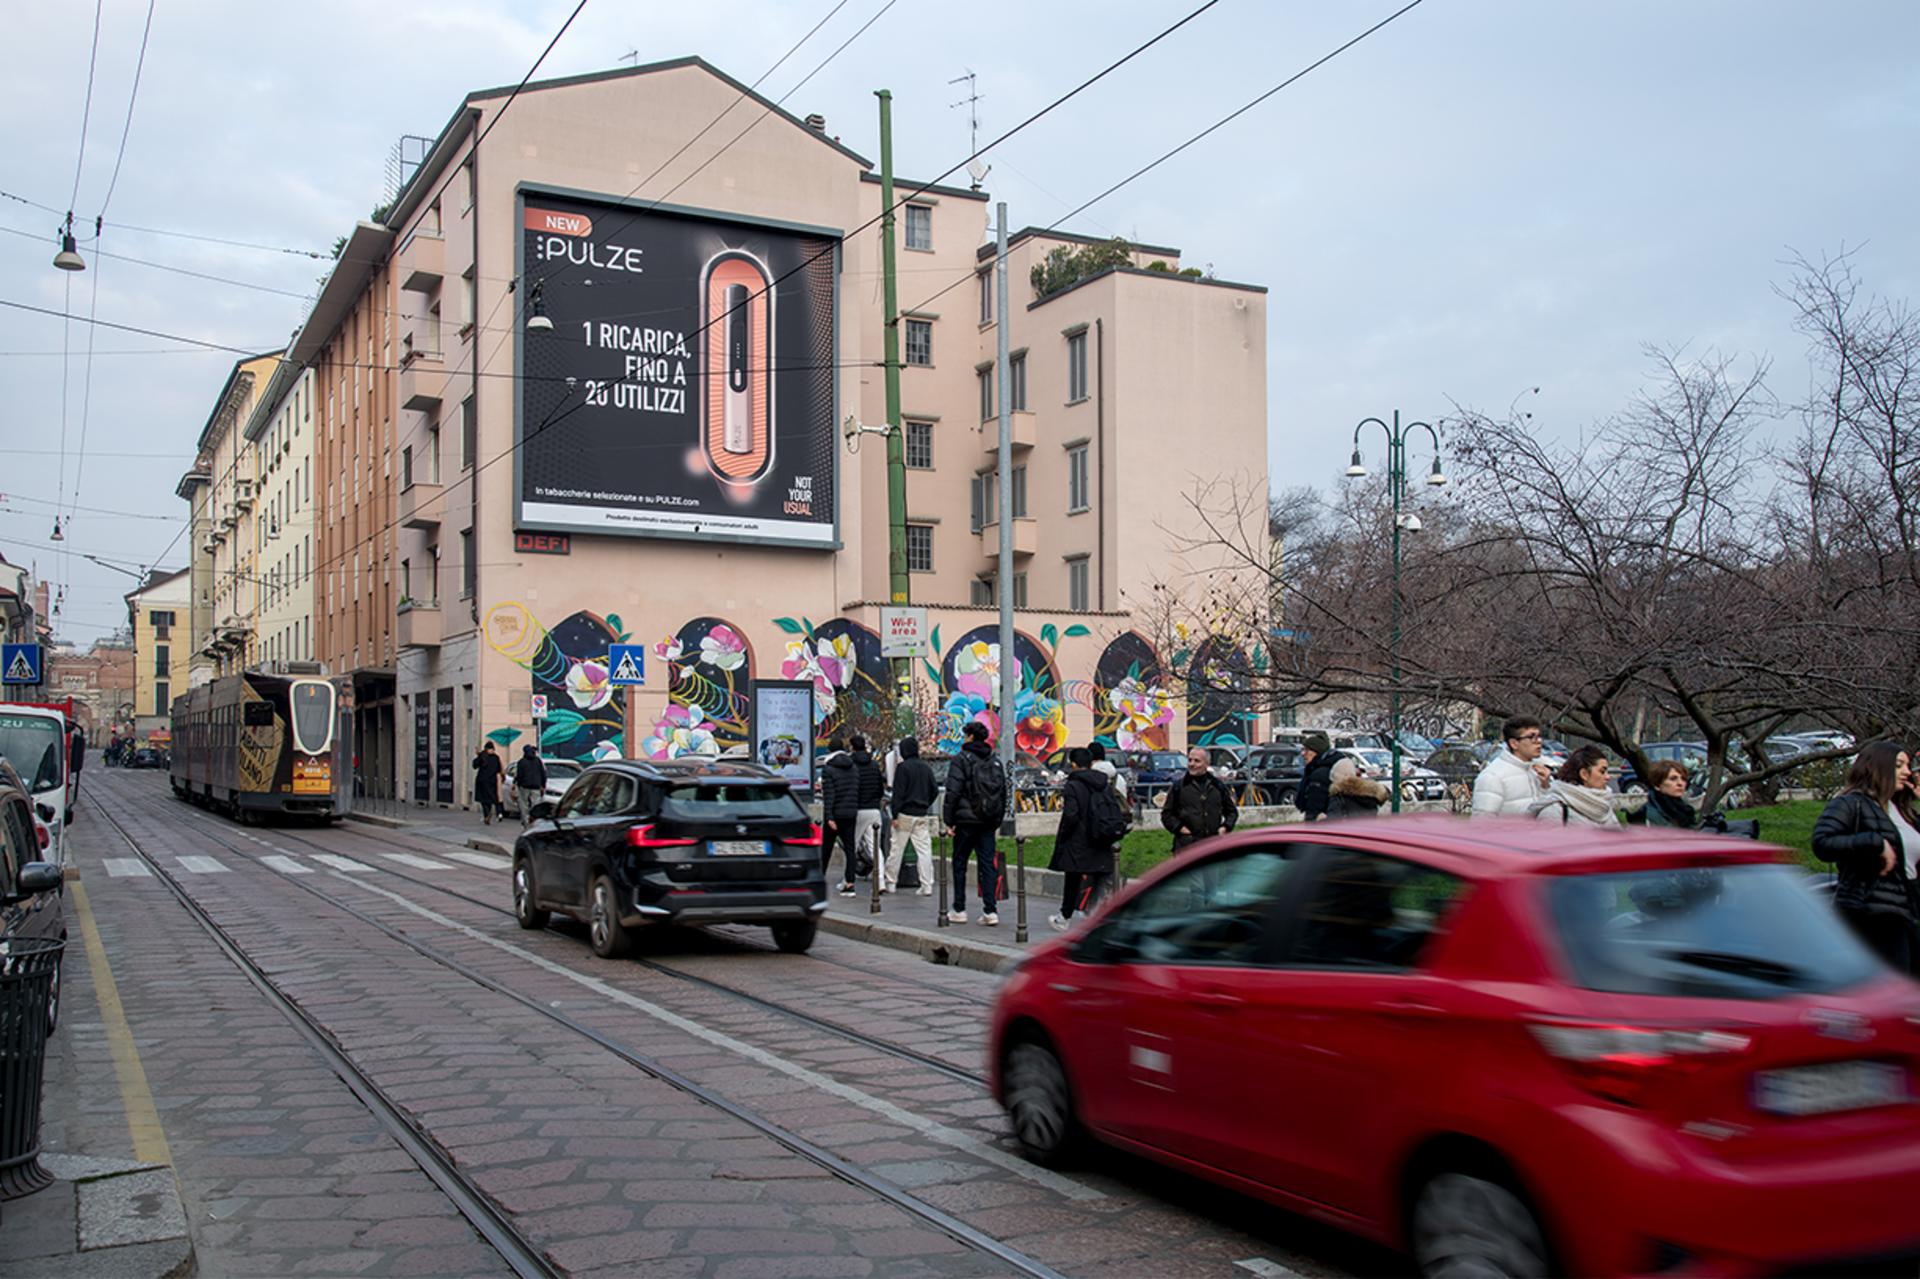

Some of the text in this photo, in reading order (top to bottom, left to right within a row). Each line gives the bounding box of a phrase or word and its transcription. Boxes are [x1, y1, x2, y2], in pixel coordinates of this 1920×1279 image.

[546, 215, 580, 231] NEW
[546, 237, 643, 273] PULZE
[583, 321, 692, 359] 1 RICARICA,
[625, 355, 687, 385] FINO A
[585, 380, 685, 414] 20 UTILIZZI
[795, 475, 812, 489] NOT
[535, 486, 544, 495] In
[545, 488, 592, 499] tabaccherie
[593, 491, 637, 502] selezionate
[655, 495, 700, 506] PULZE.com
[788, 488, 813, 502] YOUR
[783, 500, 813, 515] USUAL
[517, 535, 568, 552] DEFI
[891, 617, 917, 626] Wi-Fi
